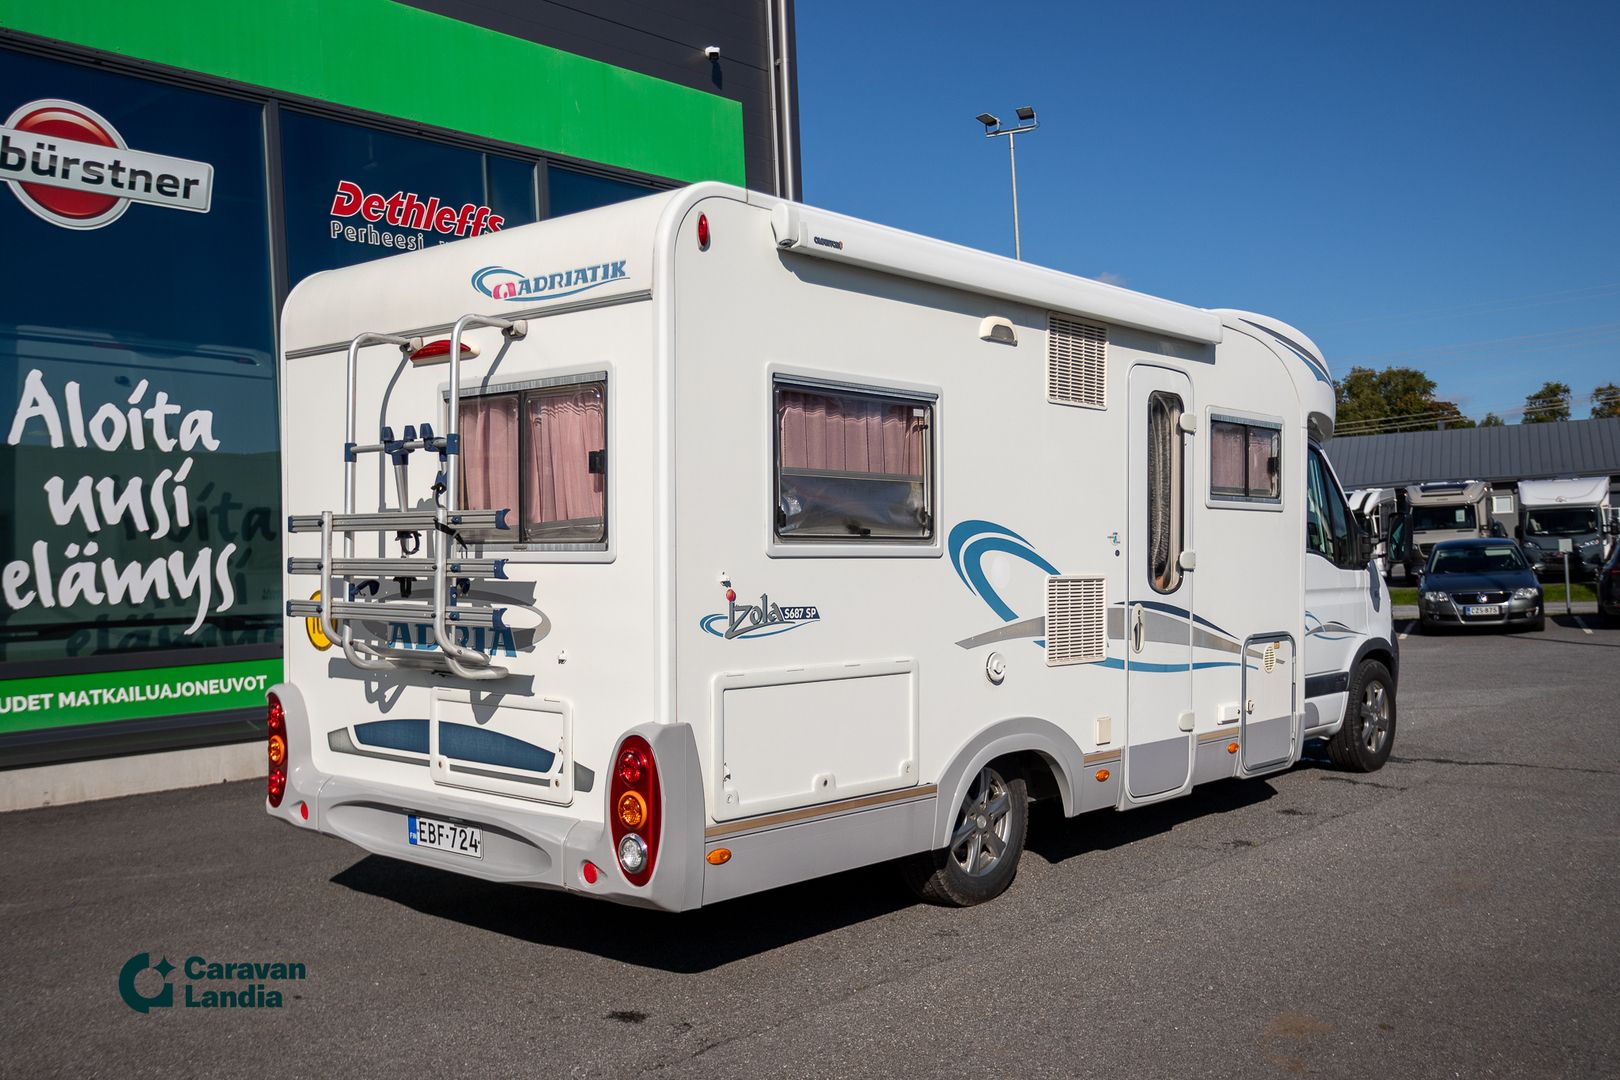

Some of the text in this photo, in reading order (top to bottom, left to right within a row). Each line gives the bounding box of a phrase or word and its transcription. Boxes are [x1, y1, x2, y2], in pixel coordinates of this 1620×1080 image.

[1, 135, 200, 199] bürstner
[330, 180, 505, 238] Dethleffs
[330, 220, 425, 250] Perheesi
[517, 260, 627, 296] ADRIATIK
[2, 539, 237, 636] elämys
[784, 608, 804, 619] S687
[805, 608, 817, 619] SP
[58, 675, 268, 709] MATKAILUAJONEUVOT
[418, 820, 478, 853] EBF-724
